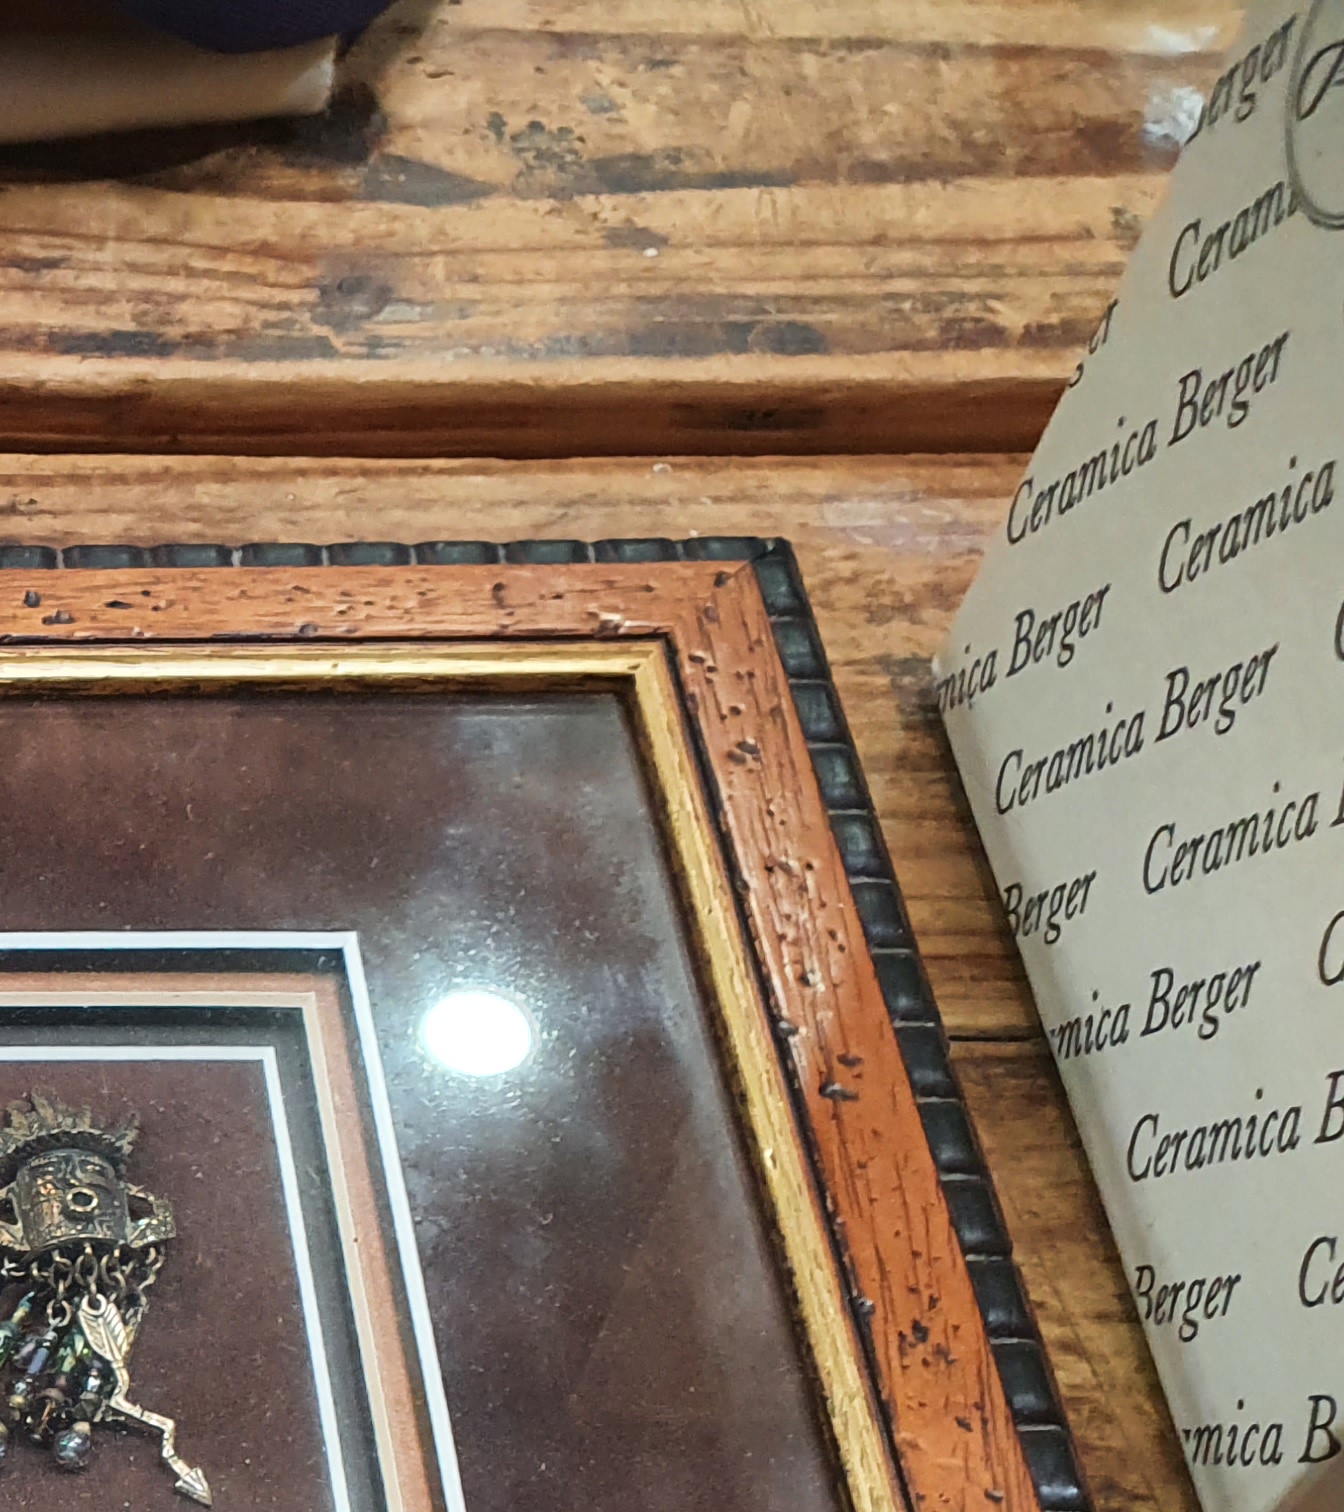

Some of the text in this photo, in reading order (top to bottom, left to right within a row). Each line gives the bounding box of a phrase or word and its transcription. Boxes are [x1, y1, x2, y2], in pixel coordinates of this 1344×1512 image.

[1006, 416, 1158, 547] Ceramica
[1167, 329, 1291, 447] Berger
[1157, 455, 1337, 595] Ceramica
[1005, 583, 1111, 678] Berger
[995, 641, 1280, 816] Ceramica Berger
[1142, 780, 1321, 896] Ceramica
[1003, 868, 1097, 945] Berger
[1139, 960, 1261, 1040] Berger
[1126, 1087, 1303, 1182] Ceramica
[1134, 1264, 1242, 1343] Berger
